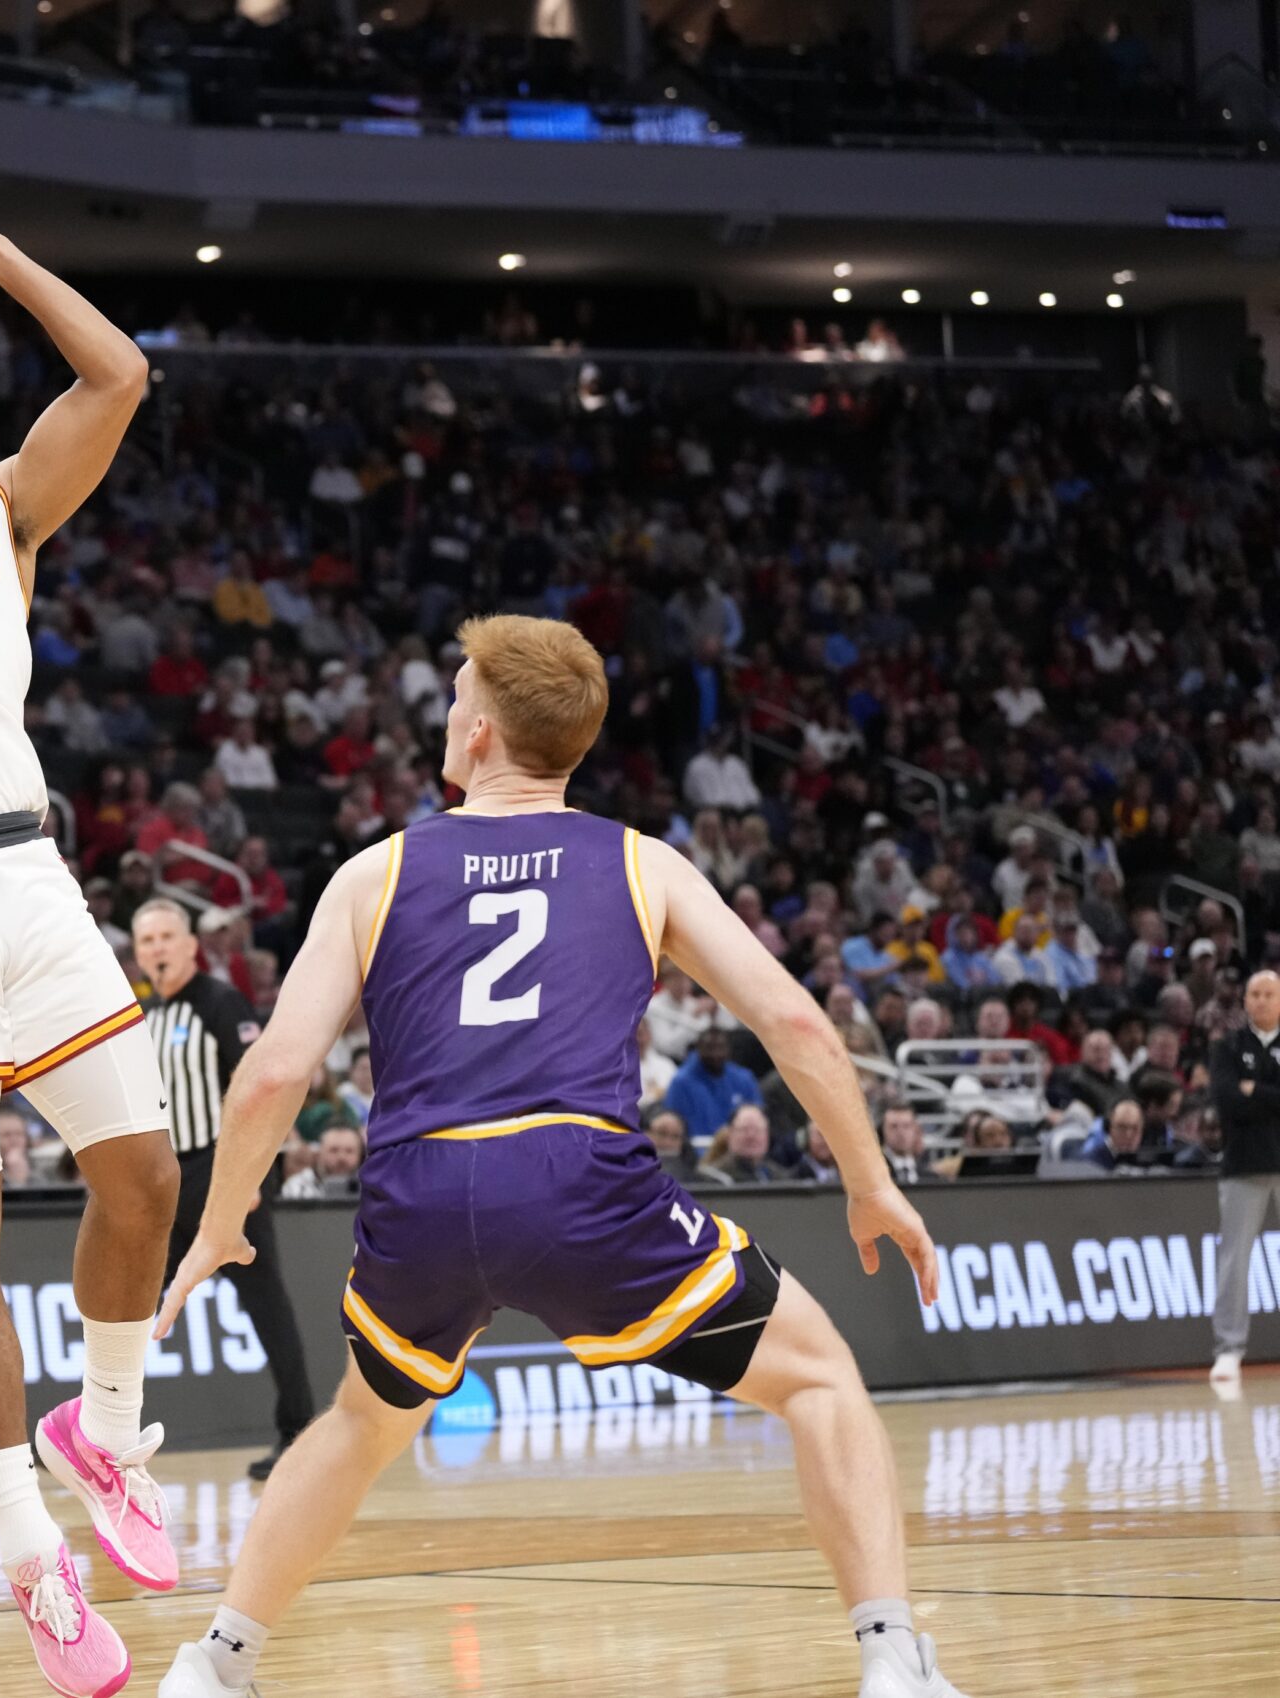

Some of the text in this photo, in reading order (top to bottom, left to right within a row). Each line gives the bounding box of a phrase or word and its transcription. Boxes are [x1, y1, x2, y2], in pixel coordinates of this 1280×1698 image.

[463, 847, 564, 885] PRUITT
[458, 888, 549, 1027] 2
[669, 1200, 706, 1248] L
